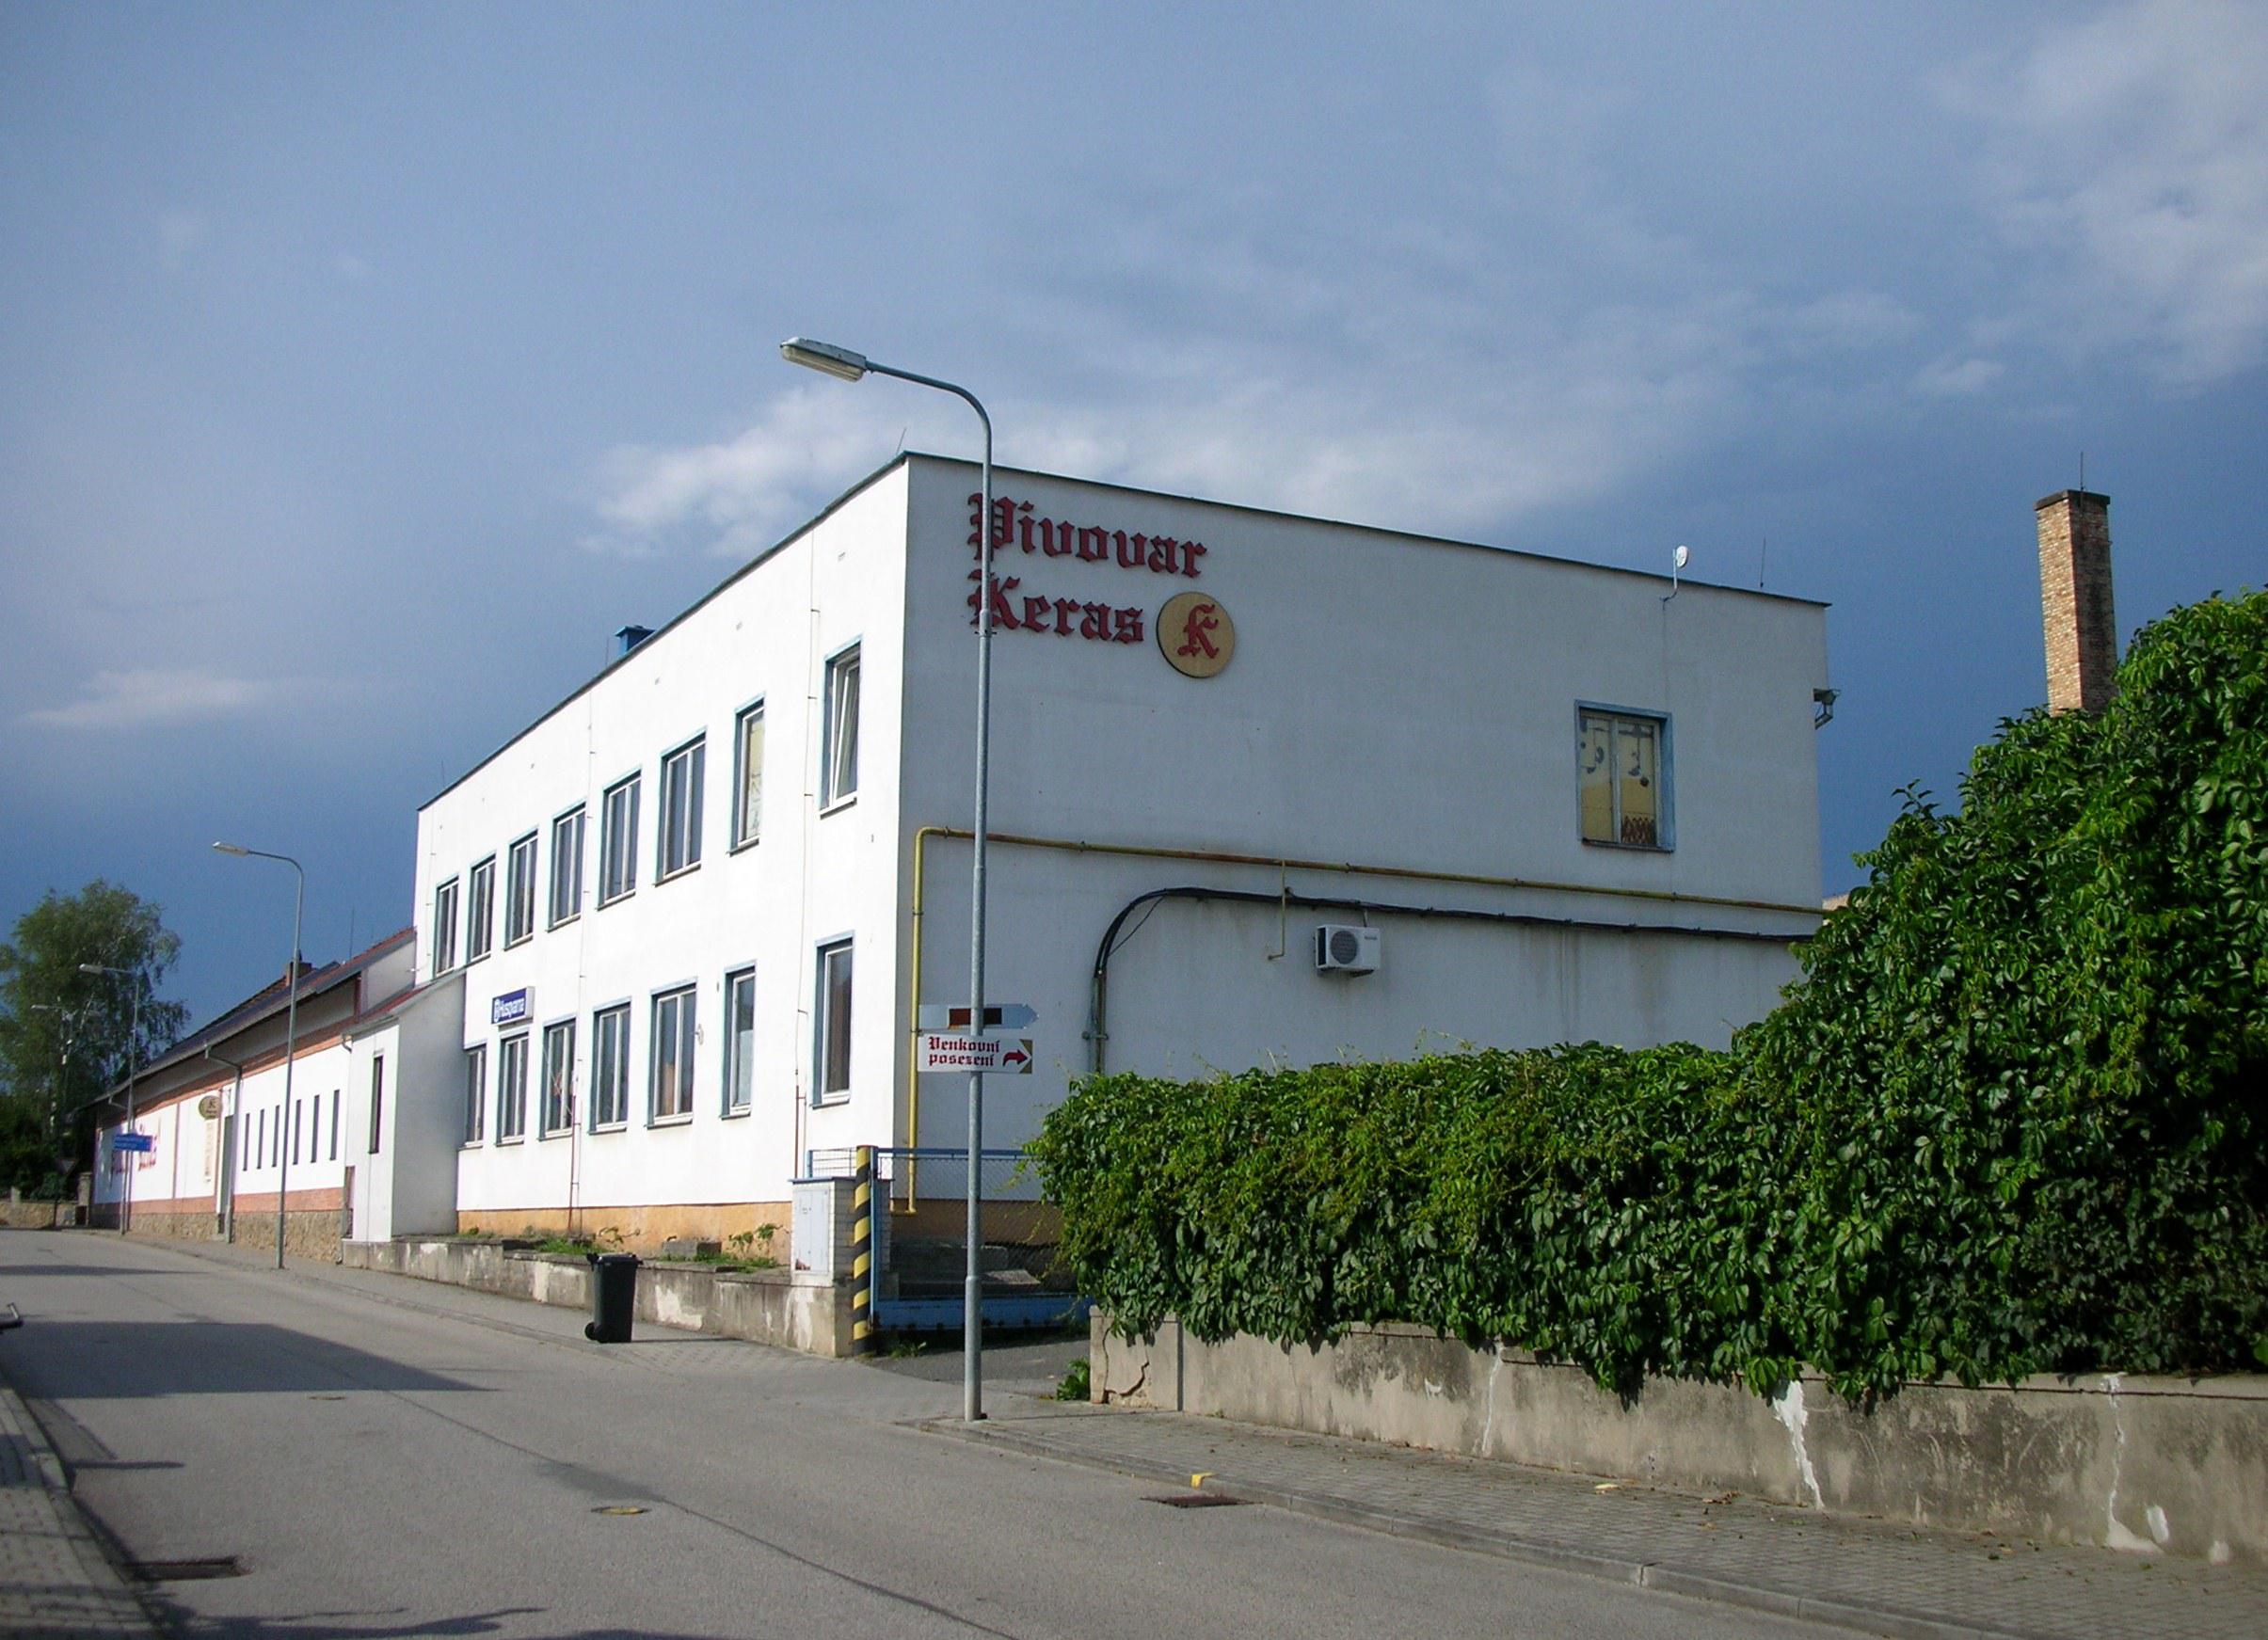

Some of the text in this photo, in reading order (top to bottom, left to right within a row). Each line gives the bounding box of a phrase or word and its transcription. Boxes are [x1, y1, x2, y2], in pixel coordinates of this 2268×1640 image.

[967, 492, 1208, 578] Pivovar
[966, 568, 1144, 645] Keras
[928, 1036, 1000, 1053] Venkovní
[929, 1054, 995, 1067] posezení
